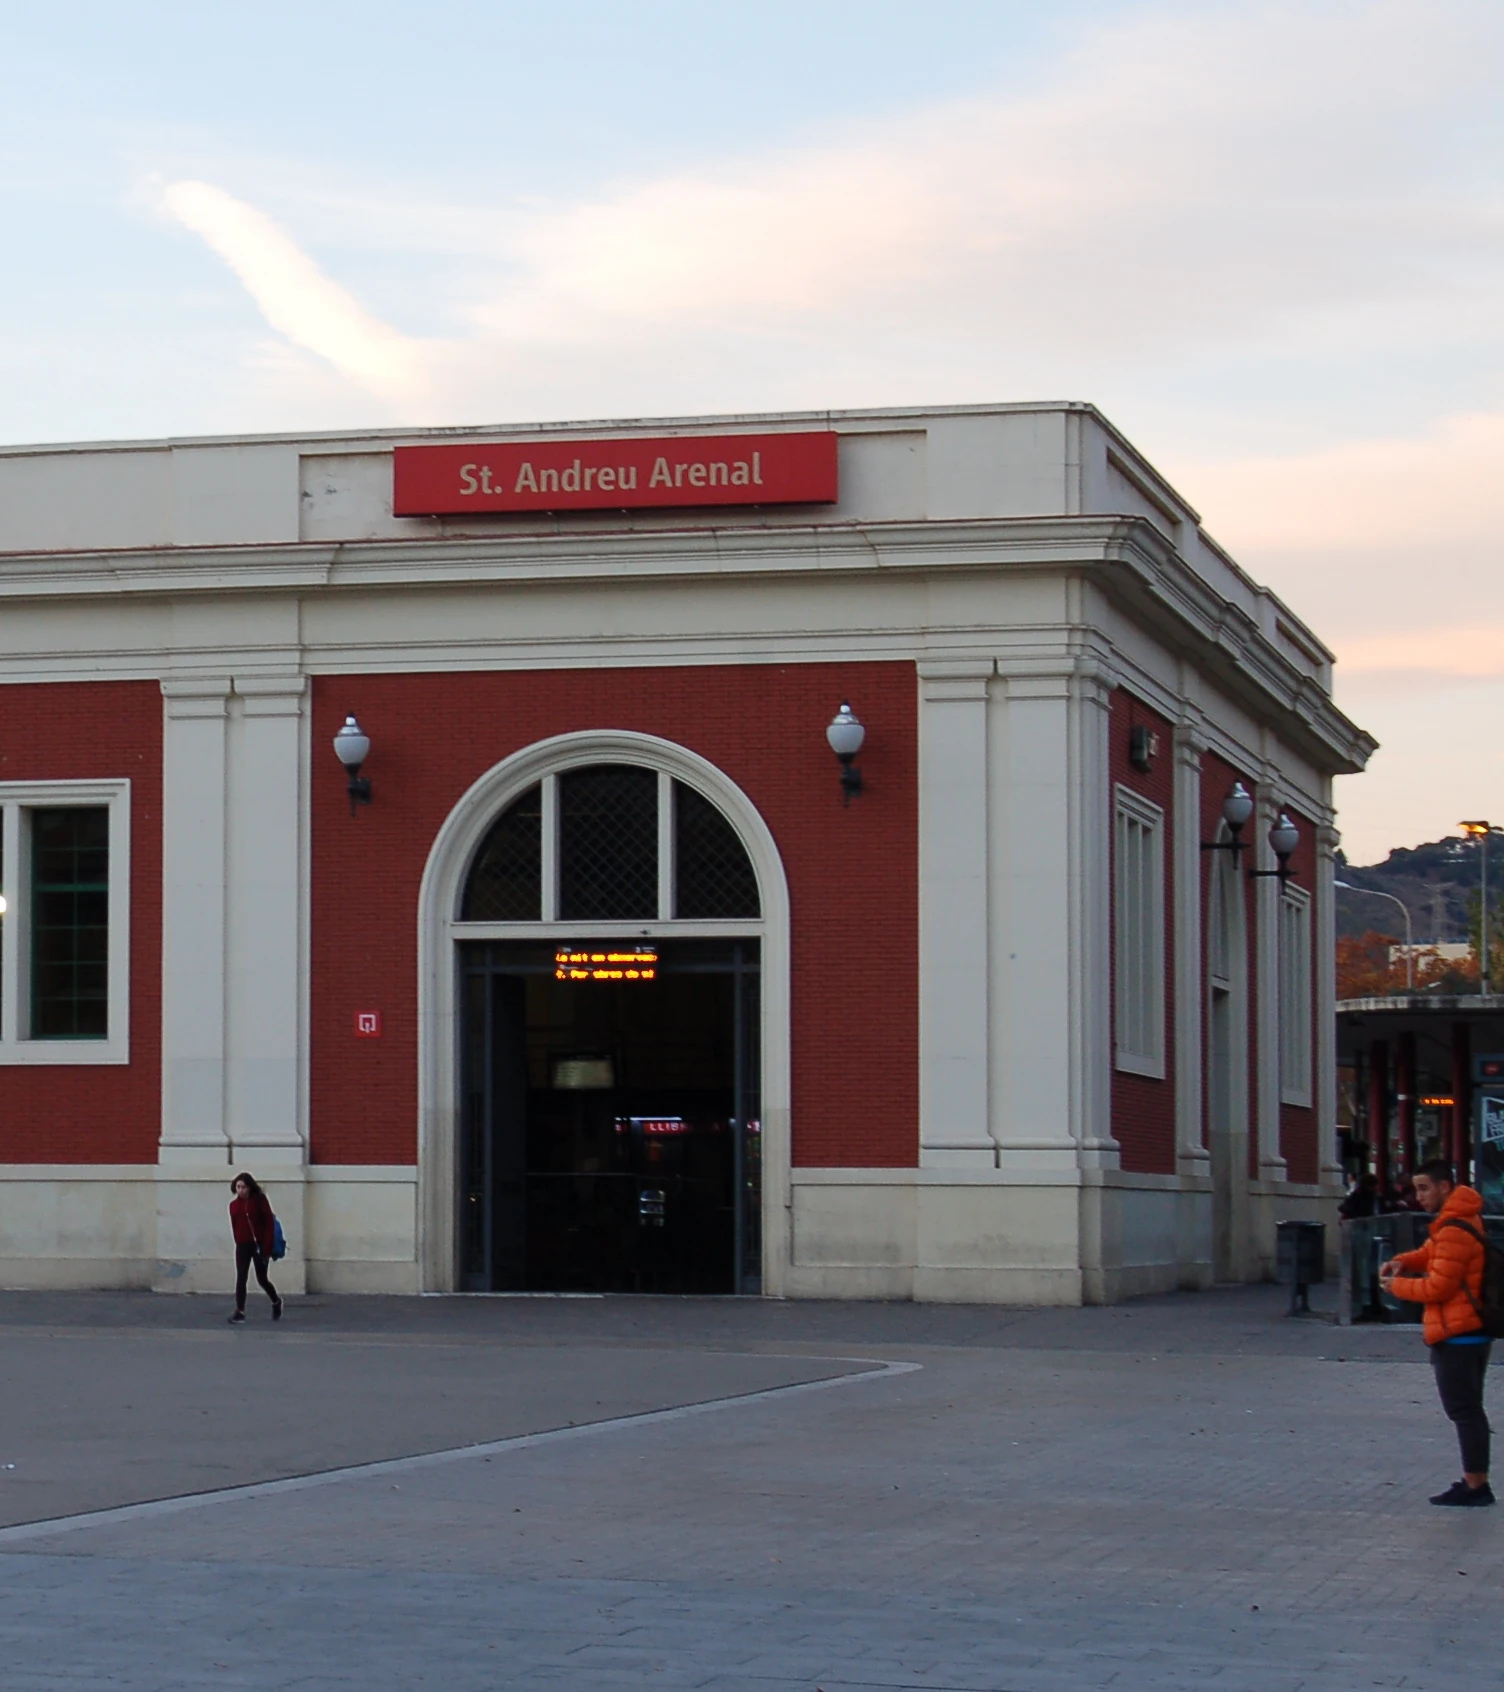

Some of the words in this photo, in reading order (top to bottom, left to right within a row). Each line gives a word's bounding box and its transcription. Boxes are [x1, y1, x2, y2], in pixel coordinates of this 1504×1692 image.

[458, 463, 503, 496] St.
[514, 459, 638, 493] Andreu
[649, 451, 763, 488] Arenal
